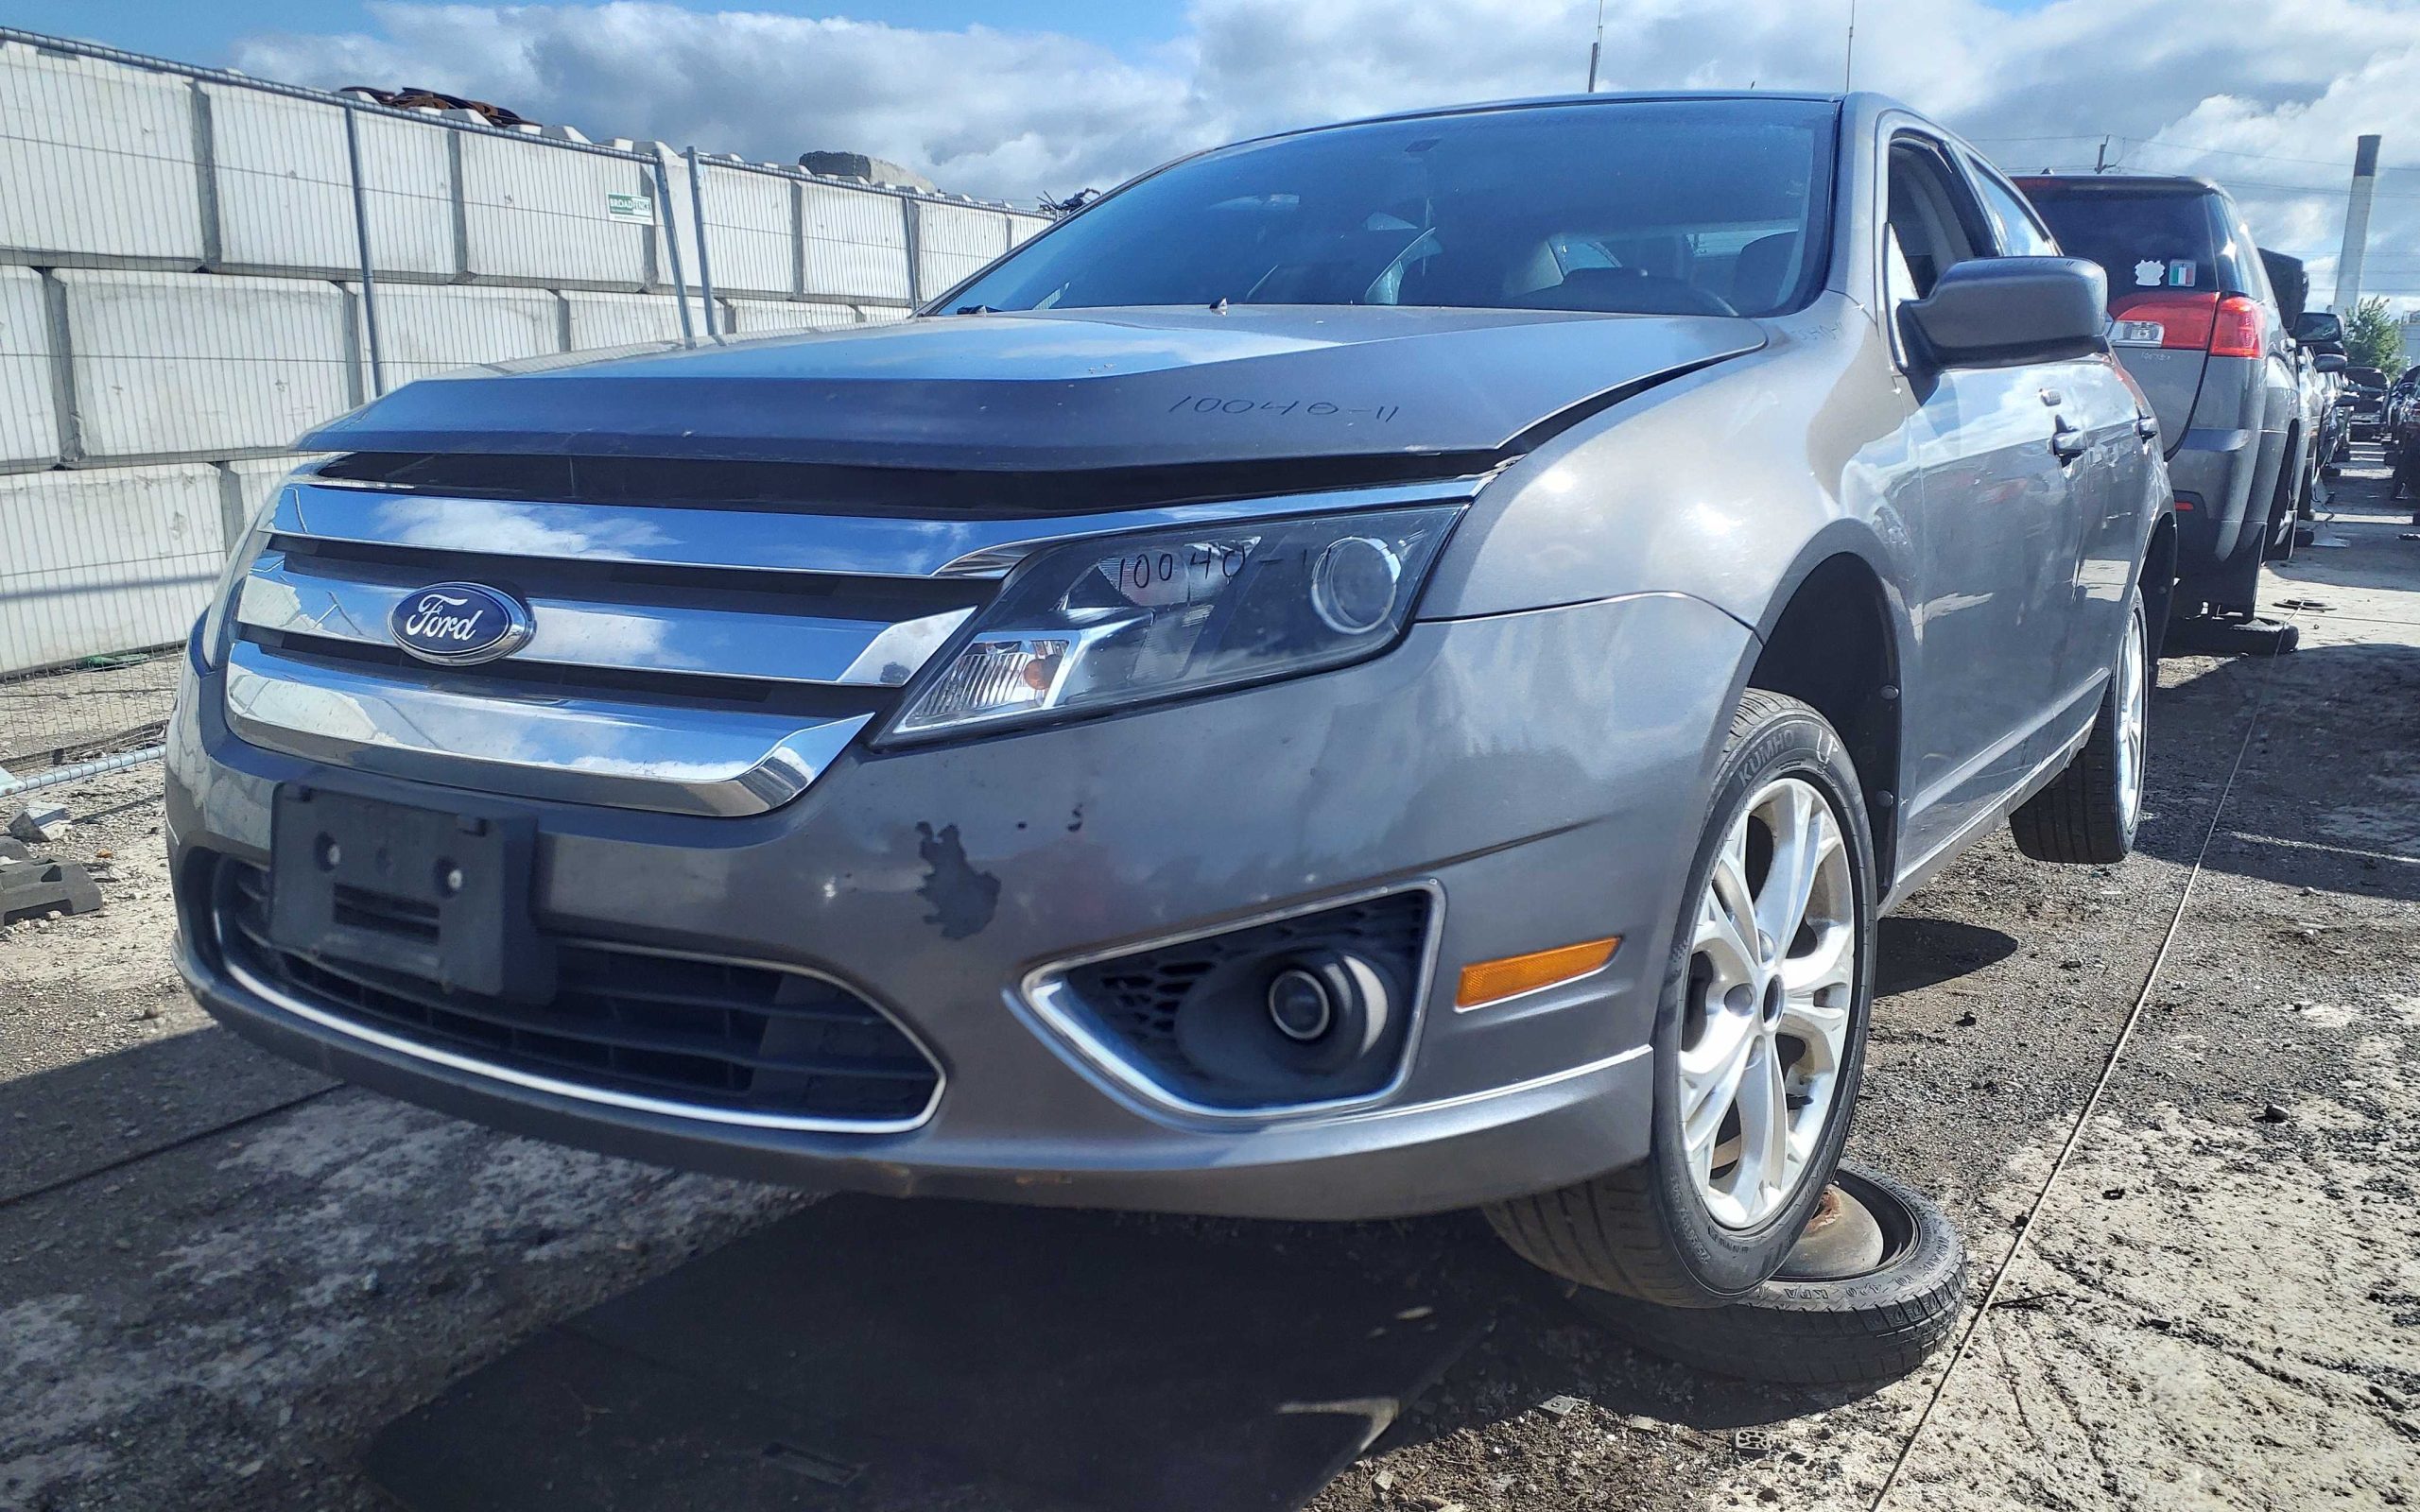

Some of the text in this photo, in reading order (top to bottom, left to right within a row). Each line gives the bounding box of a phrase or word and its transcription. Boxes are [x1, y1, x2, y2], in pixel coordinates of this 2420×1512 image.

[406, 593, 484, 641] Ford
[1738, 729, 1794, 787] KUMHO
[1784, 1287, 1829, 1300] KPA
